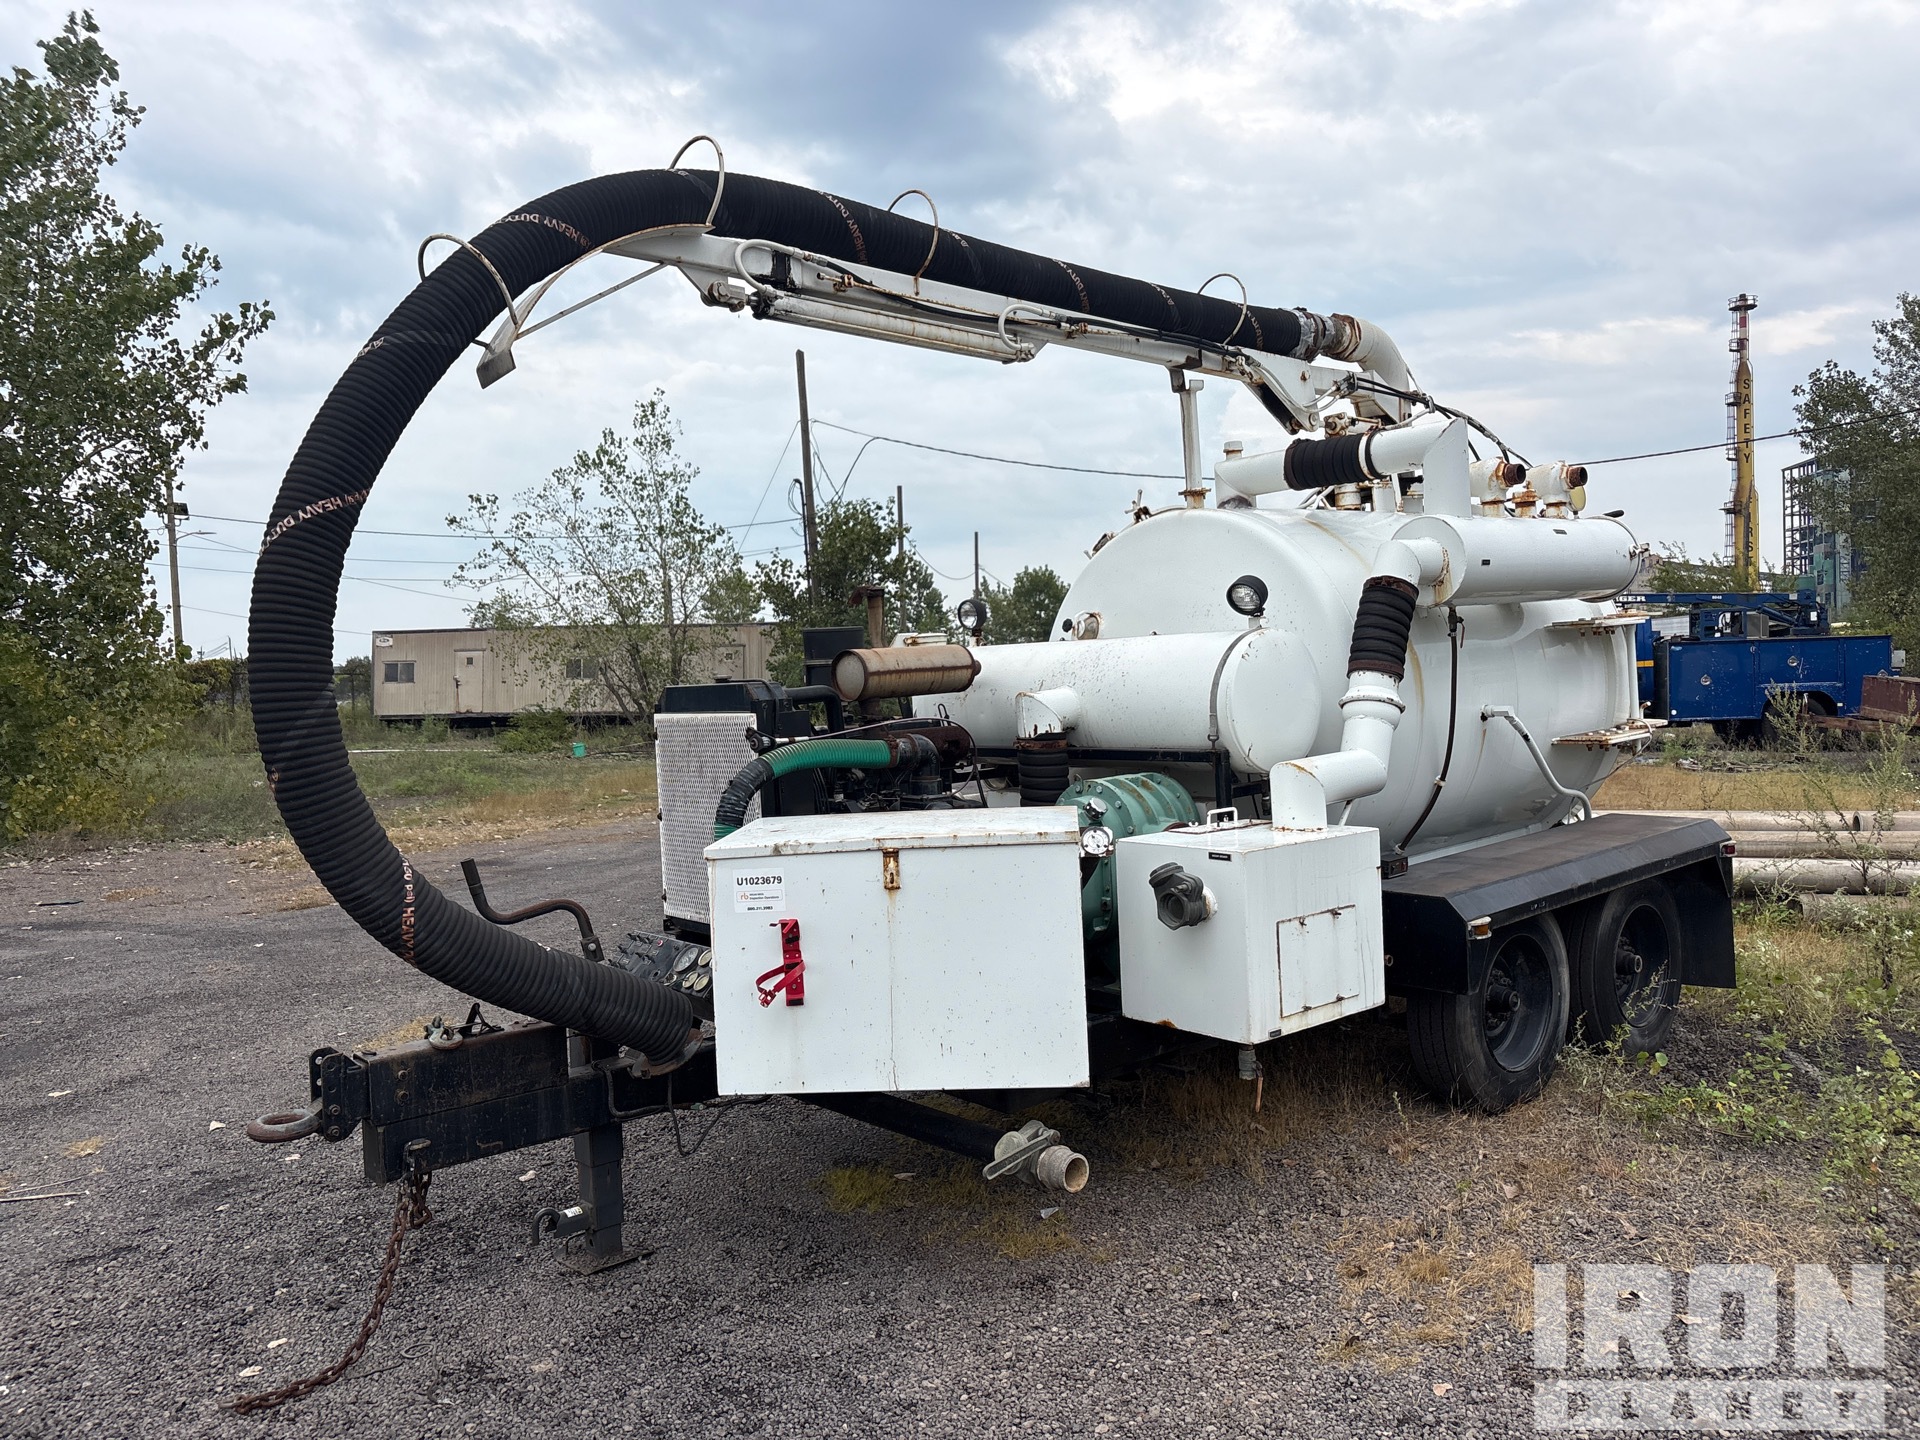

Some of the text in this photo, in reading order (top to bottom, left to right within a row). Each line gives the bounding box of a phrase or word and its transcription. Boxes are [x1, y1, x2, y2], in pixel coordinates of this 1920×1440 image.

[506, 213, 540, 223] DUTY
[827, 195, 850, 217] DUTY
[543, 216, 580, 242] HEAVY
[847, 219, 865, 250] HEAVY
[1743, 378, 1751, 463] SAFETY
[298, 496, 343, 522] HEAVY
[264, 514, 296, 548] DUTY
[1616, 595, 1646, 603] GER
[736, 875, 783, 886] U1023679
[401, 907, 416, 949] HEAVY
